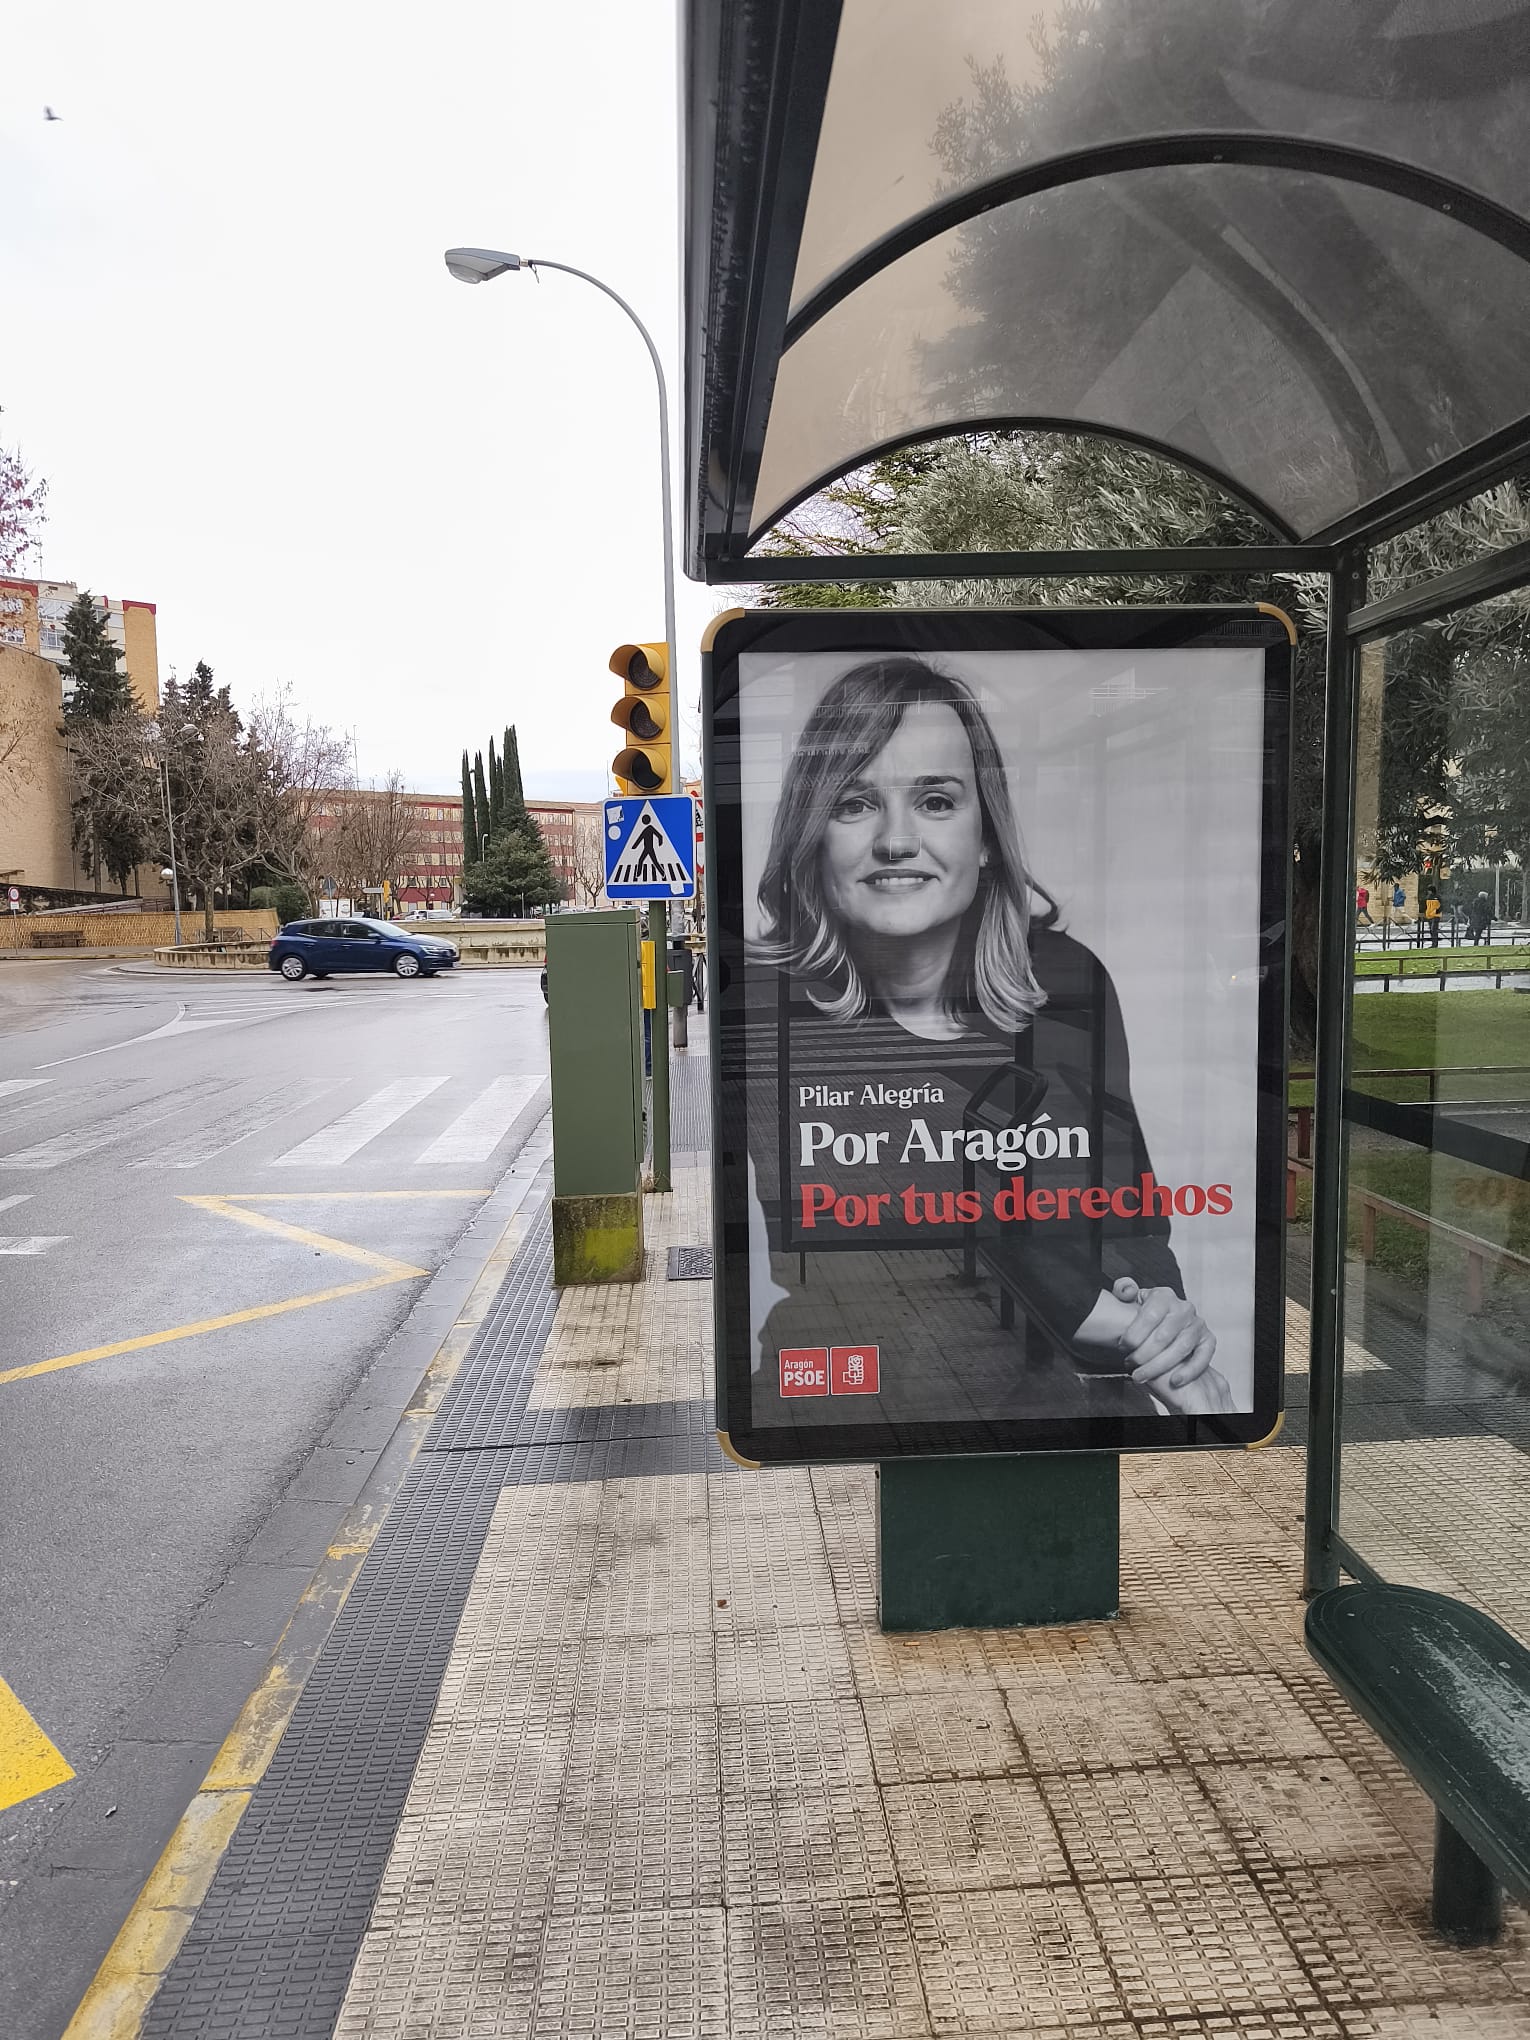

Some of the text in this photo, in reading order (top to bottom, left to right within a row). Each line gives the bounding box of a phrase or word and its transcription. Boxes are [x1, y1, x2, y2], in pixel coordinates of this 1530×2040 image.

[799, 1082, 945, 1109] Pilar Alegría
[799, 1112, 1091, 1171] Por Aragón
[800, 1173, 1233, 1228] Por tus derechos
[784, 1358, 814, 1370] Aragón
[783, 1370, 825, 1386] PSOE
